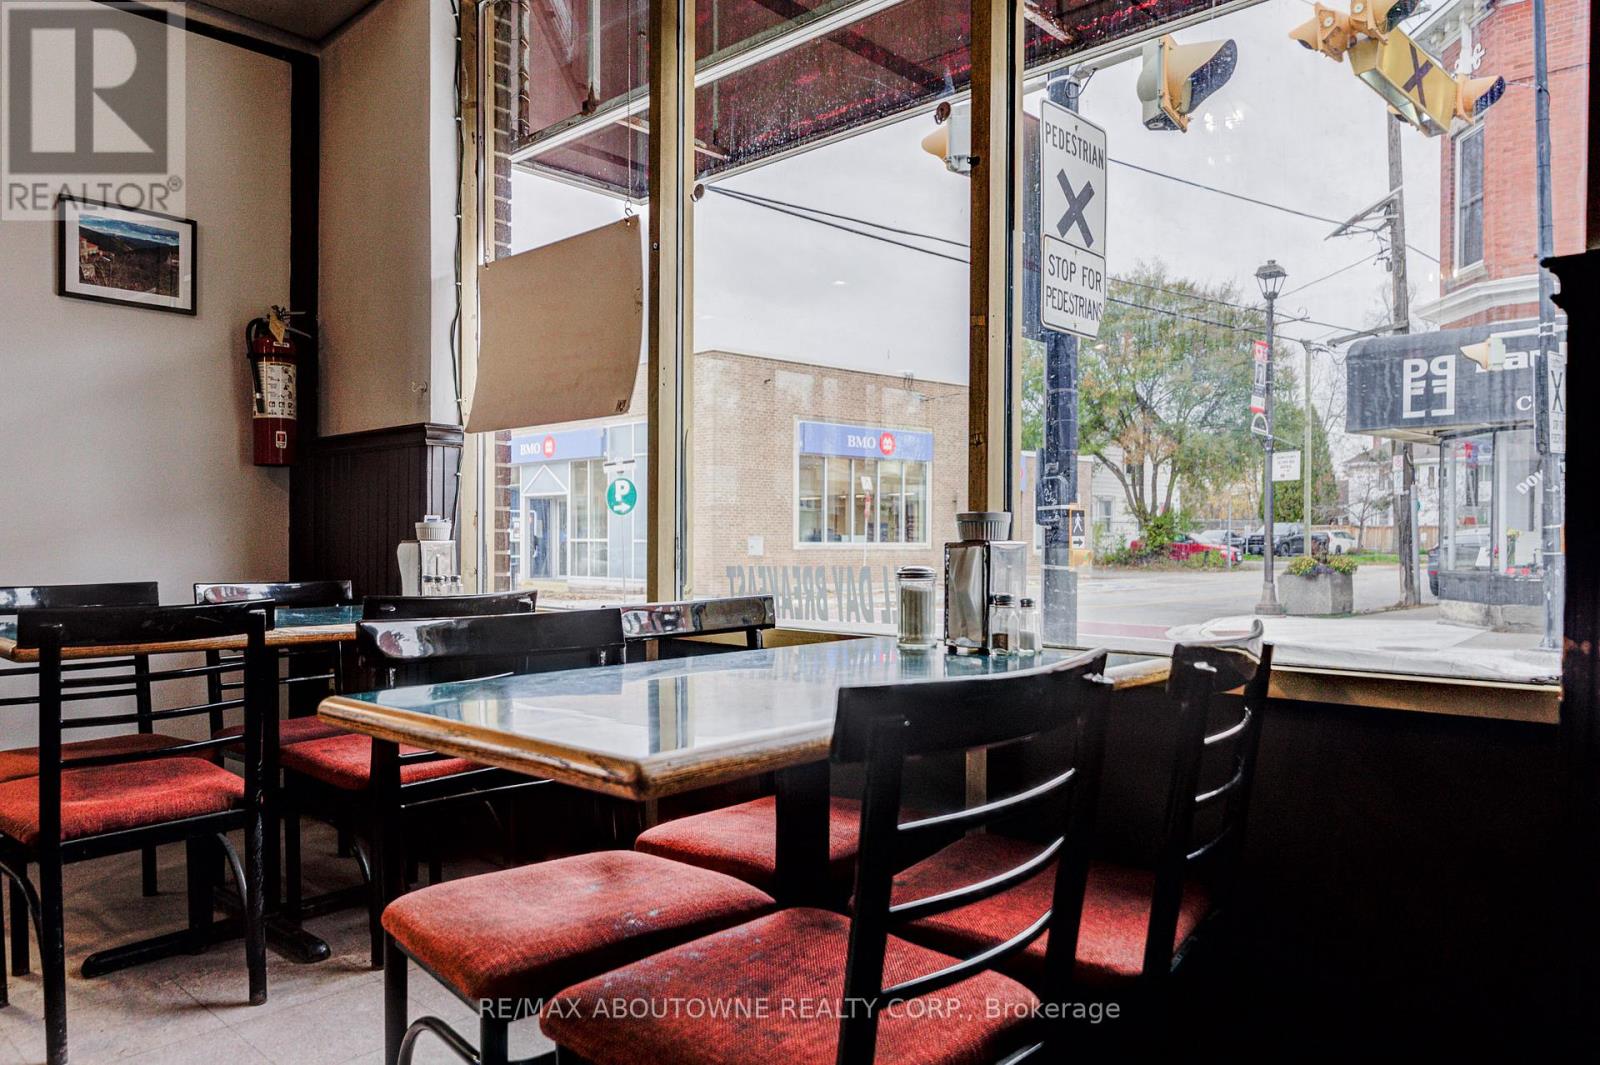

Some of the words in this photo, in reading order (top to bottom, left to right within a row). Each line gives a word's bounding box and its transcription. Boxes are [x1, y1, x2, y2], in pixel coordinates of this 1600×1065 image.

[1045, 122, 1105, 170] PEDESTRIAN
[1048, 253, 1077, 283] STOP
[1082, 266, 1102, 293] FOR
[1046, 285, 1103, 322] PEDESTRIANS
[520, 442, 541, 456] BMO
[847, 434, 876, 449] BMO
[614, 480, 631, 502] P
